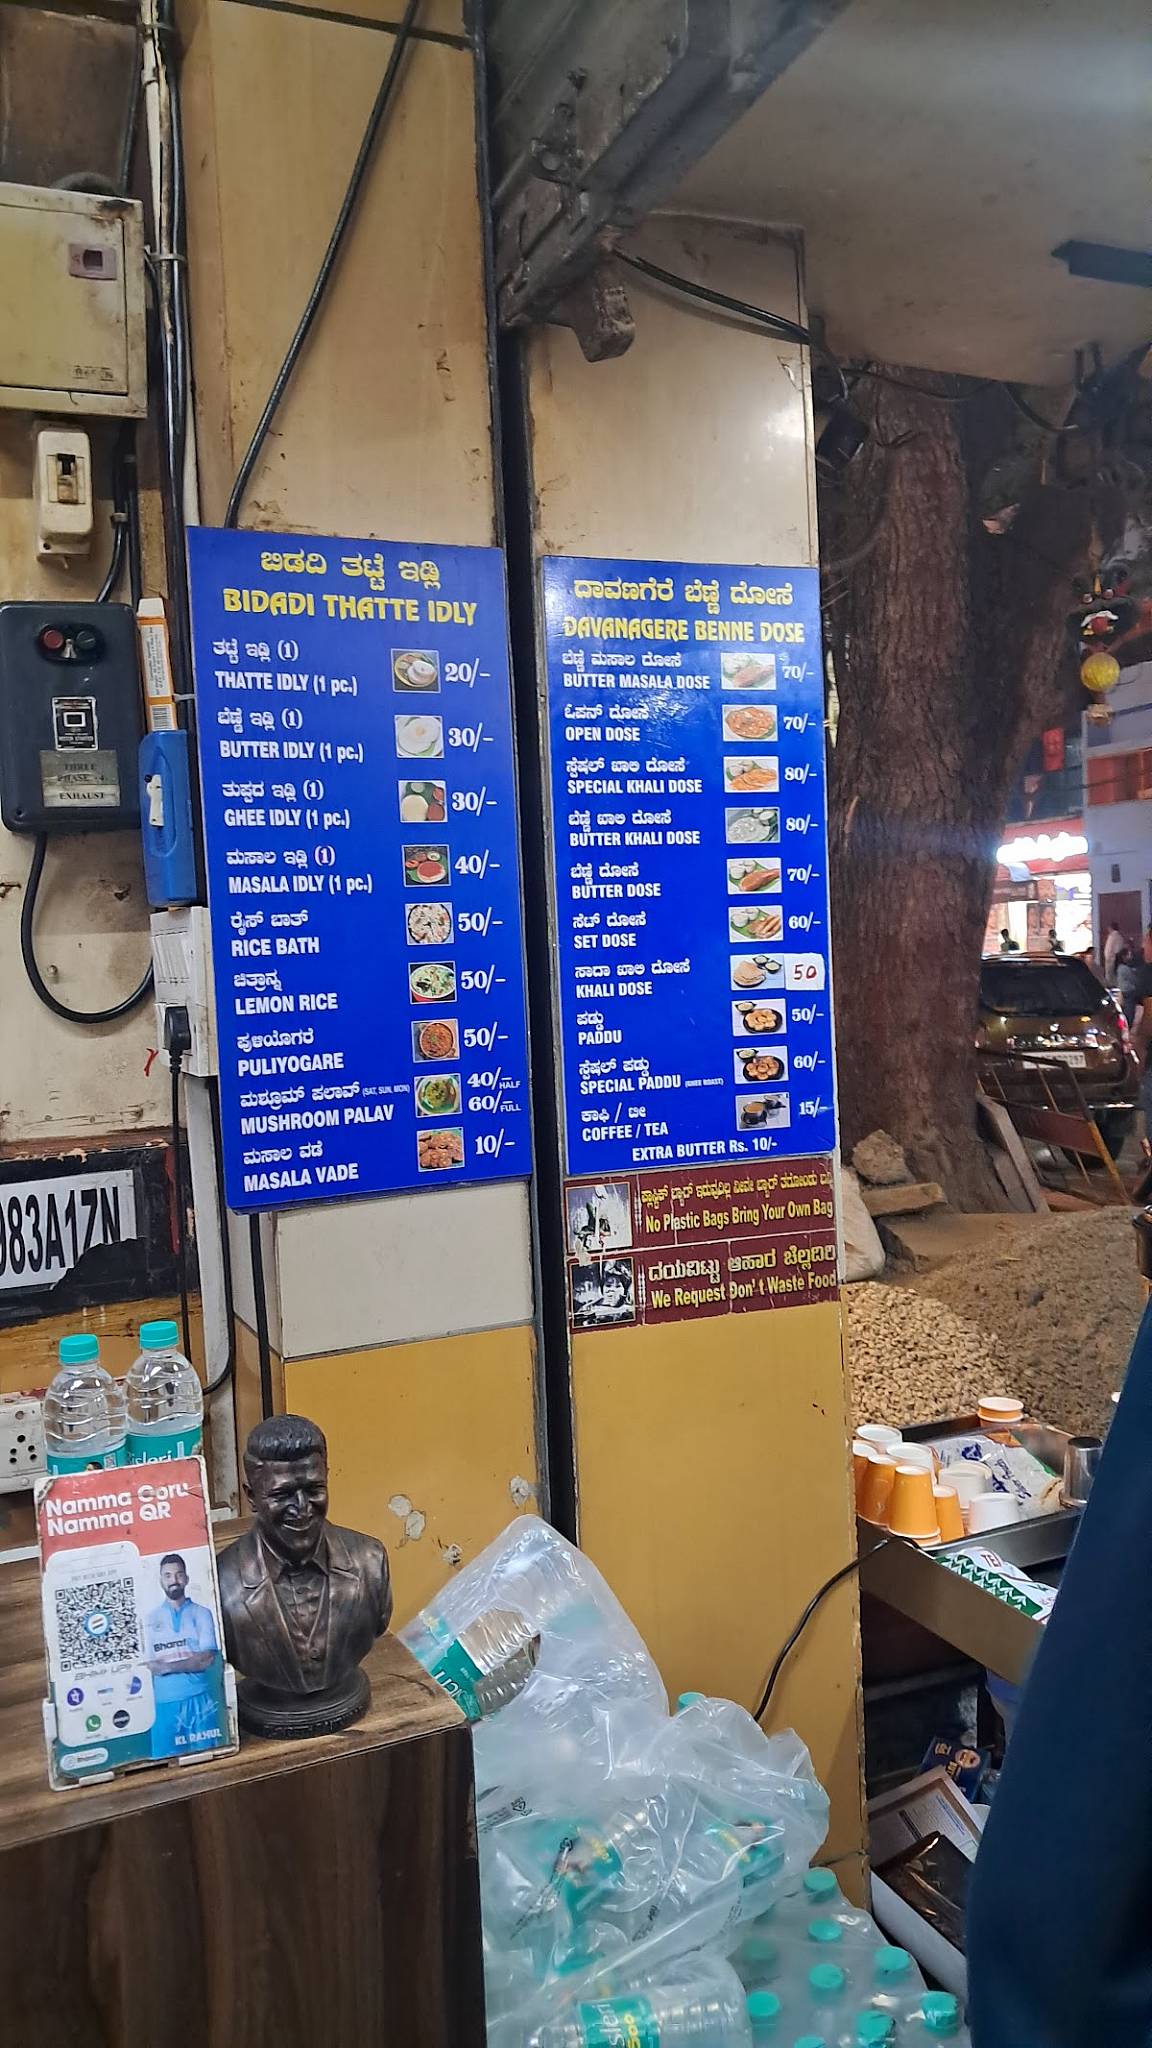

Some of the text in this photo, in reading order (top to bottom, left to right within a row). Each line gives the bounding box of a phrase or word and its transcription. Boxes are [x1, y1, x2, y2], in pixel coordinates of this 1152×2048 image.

[261, 550, 440, 591] ಬಿಡದಿ ತಟ್ಟೆ ಇಡ್ಲಿ
[573, 577, 793, 614] ದಾವಣಗೆರೆ ಬೆಣ್ಣೆ ದೋಸೆ
[223, 589, 476, 626] BIDADI THATTE IDLY
[562, 616, 805, 642] DAVANAGERE BENNE DOSE
[213, 639, 298, 664] ತಟ್ಟೆ ಇಡ್ಲಿ (1)
[562, 650, 681, 672] ಬೆಣ್ಣೆ ಮಸಾಲ ದೋಸೆ
[445, 658, 490, 687] 20/-
[564, 674, 710, 690] BUTTER MASALA DOSE
[782, 661, 814, 682] 70/-
[215, 671, 357, 696] THATTE IDLY (1 pc.)
[218, 707, 302, 733] ಬೆಣ್ಣೆ ಇಡ್ಲಿ (1)
[609, 704, 649, 719] ದೋಸೆ
[784, 713, 816, 733] 70/-
[449, 723, 493, 752] 30/-
[566, 727, 640, 741] OPEN DOSE
[220, 741, 363, 763] BUTTER IDLY (1 pc.)
[566, 757, 685, 778] ಸ್ಪೆಷಲ್ ಖಾಲಿ ದೋಸೆ
[785, 764, 816, 784] 80/-
[59, 792, 105, 800] EXHAUST
[222, 780, 323, 803] ತುಪ್ಪದ ಇಡ್ಲಿ (1)
[568, 780, 702, 794] SPECIAL KHALI DOSE
[452, 787, 497, 816] 30/-
[224, 809, 350, 830] GHEE IDLY (1 pc.)
[569, 809, 671, 832] ಬೆಣ್ಣೆ ಖಾಲಿ ದೋಸೆ
[786, 815, 818, 834] 80/-
[570, 831, 700, 846] BUTTER KHALI DOSE
[227, 846, 335, 868] ಮಸಾಲ ಇಡ್ಲಿ (1)
[455, 850, 500, 879] 40/-
[571, 862, 639, 884] ಬೆಣ್ಣೆ ದೋಸೆ
[787, 865, 819, 884] 70/-
[229, 875, 372, 894] MASALA IDLY (1 pc.)
[572, 883, 661, 899] BUTTER DOSE
[231, 910, 308, 935] ರೈಸ್ ಬಾತ್
[458, 907, 502, 936] 50/-
[573, 911, 646, 928] ಸೆಟ್ ದೋಸೆ
[789, 912, 820, 932] 60/-
[232, 937, 319, 956] RICE BATH
[574, 934, 636, 949] SET DOSE
[575, 958, 690, 978] ಸಾದಾ ಖಾಲಿ ದೋಸೆ
[794, 964, 816, 980] 50
[234, 970, 282, 991] ಚಿತ್ರಾನ್ನ
[461, 965, 505, 993] 50/-
[576, 982, 652, 998] KHALI DOSE
[236, 993, 338, 1014] LEMON RICE
[792, 1004, 823, 1024] 50/-
[577, 1011, 604, 1030] ಪಡ್ಡು
[464, 1022, 508, 1051] 50/-
[579, 1030, 621, 1045] PADDU
[238, 1053, 344, 1076] PULIYOGARE
[579, 1057, 650, 1080] ಸ್ಪೆಷಲ್ ಪಡ್ಡು
[794, 1052, 825, 1071] 60/-
[312, 1082, 359, 1100] ಪಲಾವ್
[499, 1079, 521, 1089] HALF
[581, 1074, 681, 1094] SPECIAL PADDU
[501, 1102, 521, 1112] FULL
[581, 1103, 646, 1123] ಕಾಫಿ / ಟೀ
[800, 1097, 828, 1117] 15/-
[241, 1104, 393, 1134] MUSHROOM PALAV
[583, 1122, 668, 1141] COFFEE / TEA
[243, 1141, 322, 1164] ಮಸಾಲ ವಡೆ
[475, 1129, 515, 1157] 10/-
[633, 1137, 777, 1161] EXTRA BUTTER Rs. 10/-
[244, 1163, 358, 1192] MASALA VADE
[646, 1199, 833, 1232] No Plastic Bags Bring Your Own Bag
[651, 1290, 671, 1308] We
[675, 1284, 726, 1307] Request
[767, 1277, 804, 1293] Waste
[808, 1269, 836, 1289] Food
[46, 1492, 132, 1517] Namma
[48, 1502, 171, 1536] Namma QR
[175, 1728, 223, 1745] KL RAHUL
